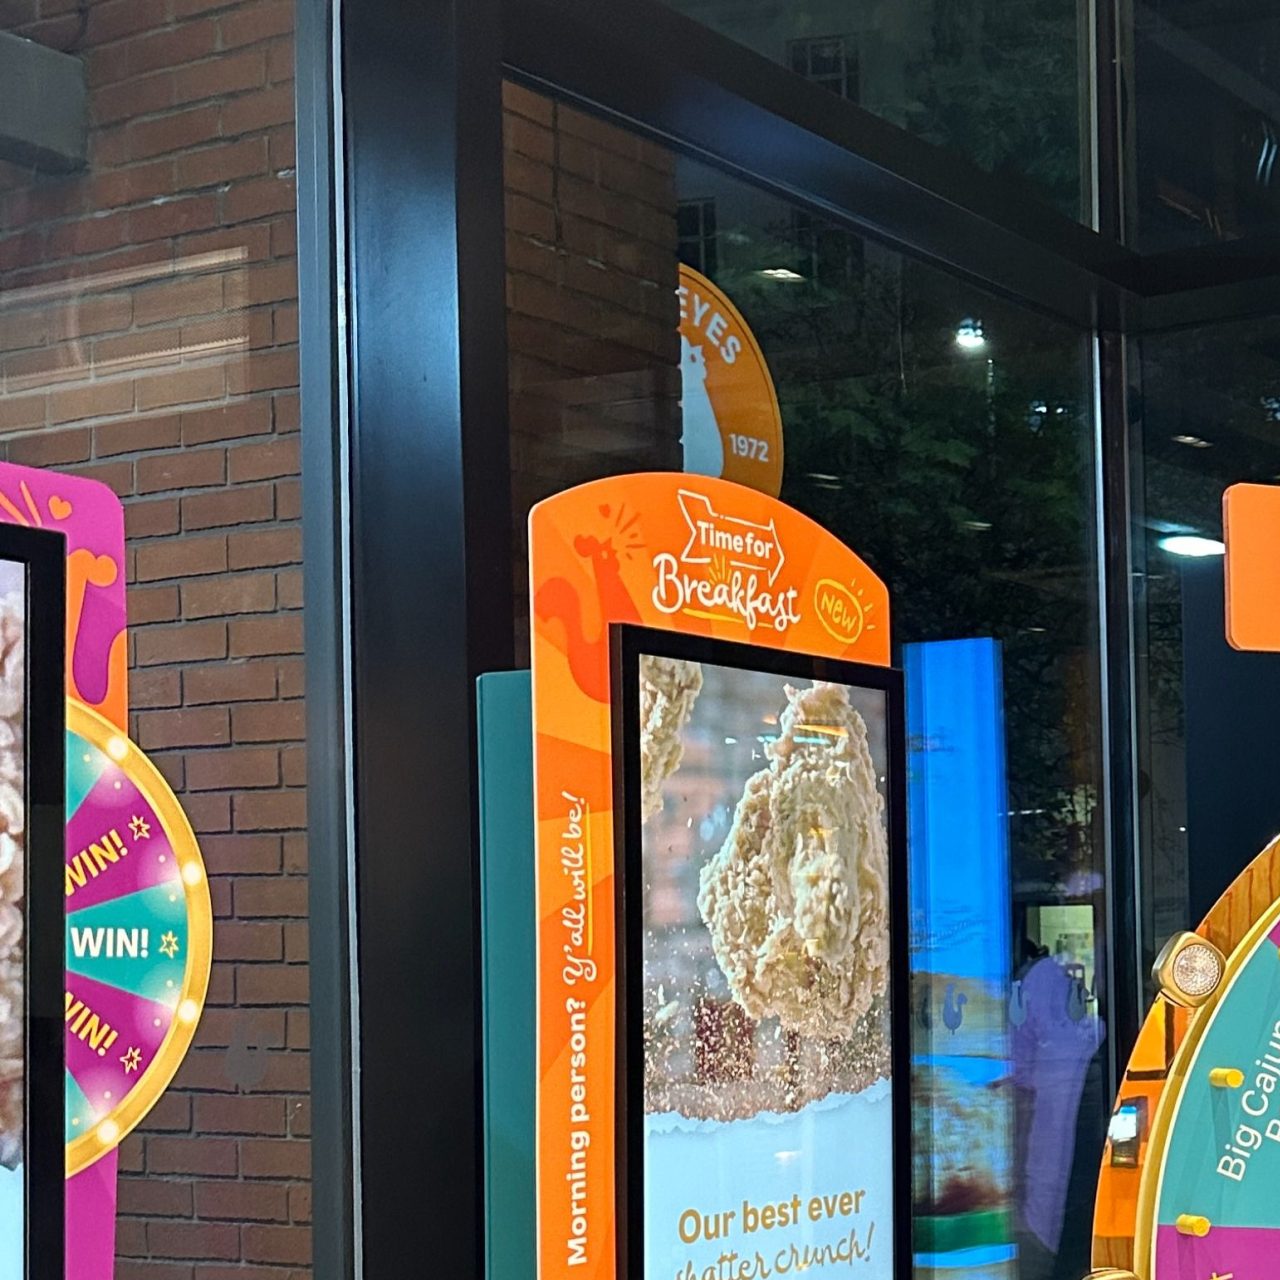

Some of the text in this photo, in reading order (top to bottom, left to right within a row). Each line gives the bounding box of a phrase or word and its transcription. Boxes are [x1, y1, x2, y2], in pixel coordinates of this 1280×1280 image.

[729, 433, 769, 462] 1972
[696, 520, 774, 559] Time for
[652, 553, 801, 631] Breakfast
[561, 790, 586, 839] be!
[561, 842, 586, 900] will
[70, 927, 149, 959] WIN!
[566, 997, 590, 1123] person?
[1216, 1122, 1263, 1182] Big
[566, 1130, 590, 1266] Morning
[678, 1189, 866, 1244] Our best ever
[775, 1221, 875, 1274] crunch!
